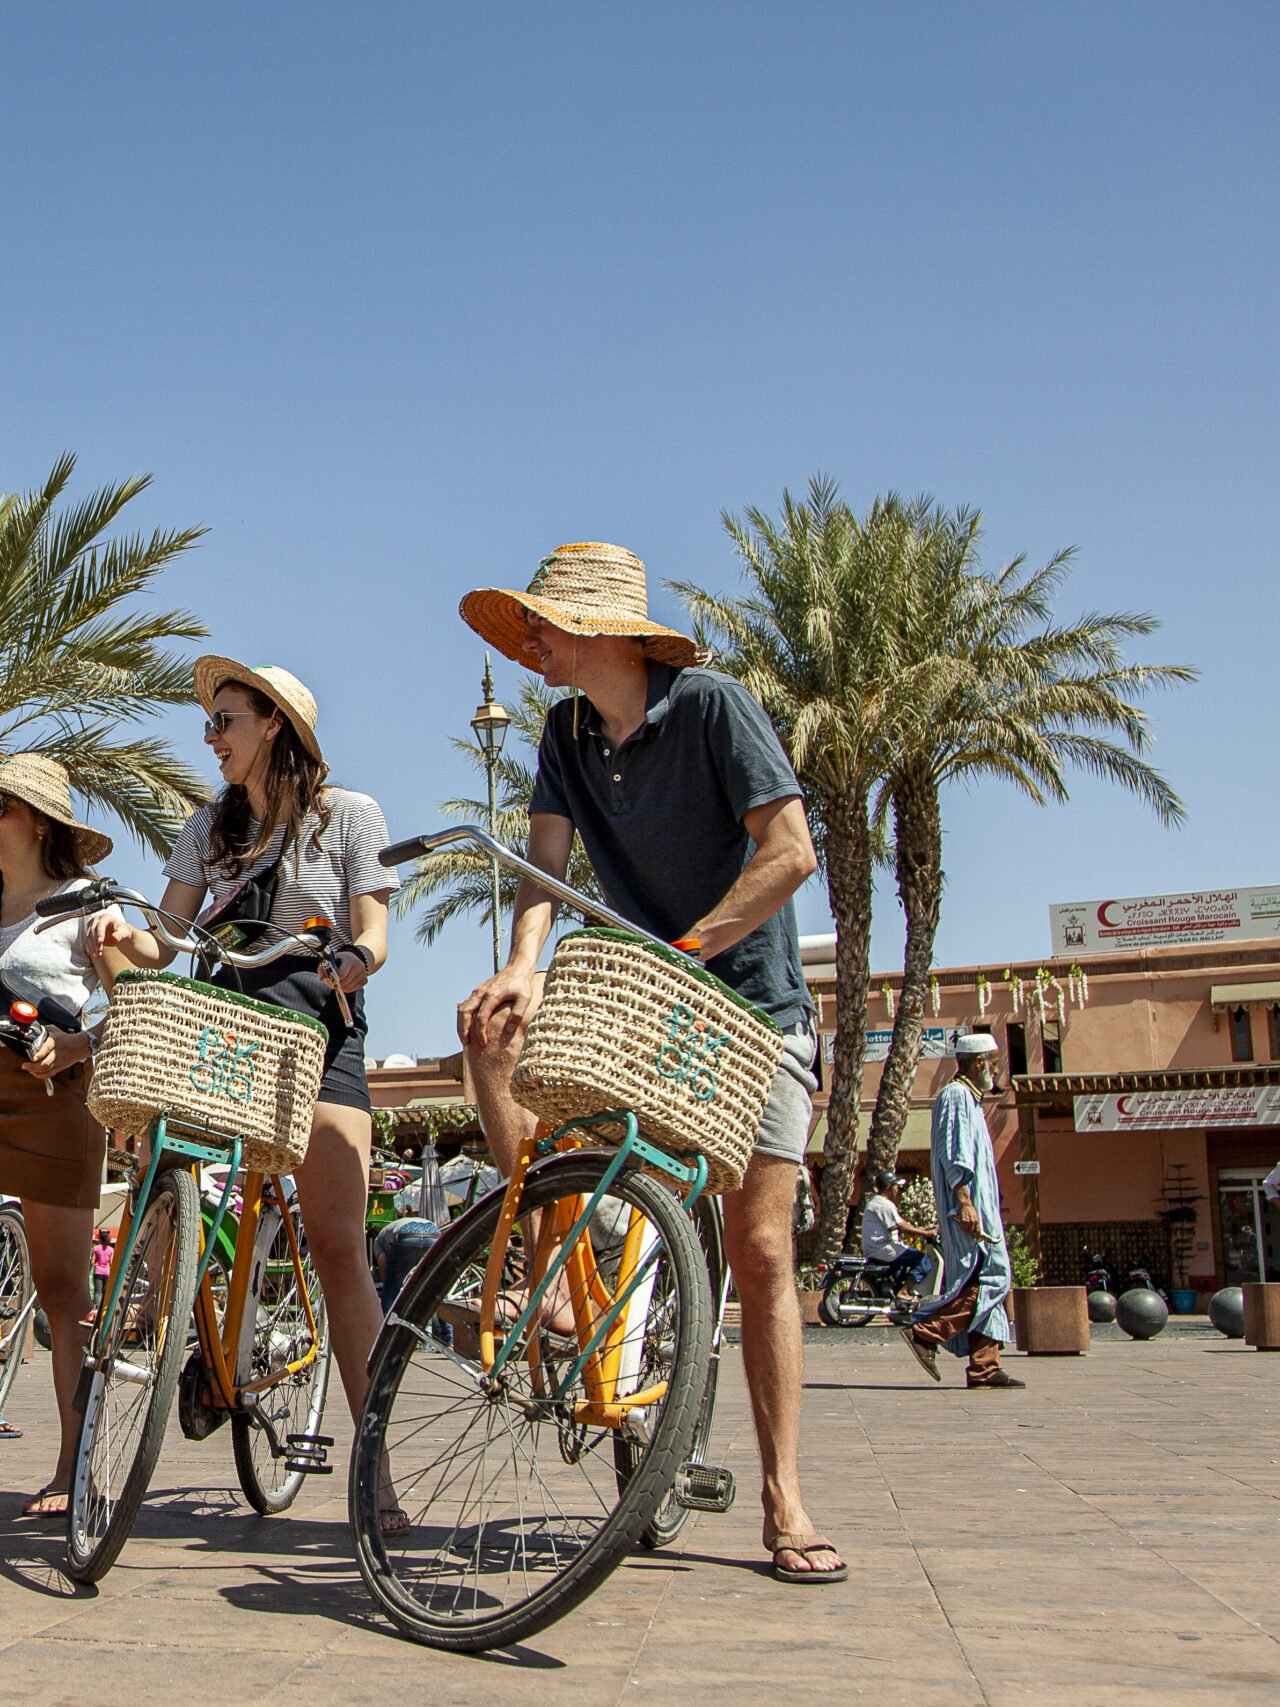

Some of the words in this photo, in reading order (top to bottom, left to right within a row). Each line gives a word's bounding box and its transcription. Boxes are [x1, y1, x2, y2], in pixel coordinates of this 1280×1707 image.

[1122, 898, 1166, 912] المغربي
[1168, 894, 1204, 908] الأحمر
[1206, 892, 1238, 904] الهلال
[1126, 917, 1167, 927] Croissant
[1168, 914, 1196, 924] Rouge
[1197, 911, 1237, 921] Marocain
[1139, 1109, 1182, 1117] Croissant
[1183, 1107, 1212, 1115] Rouge
[1213, 1105, 1255, 1113] Marocain
